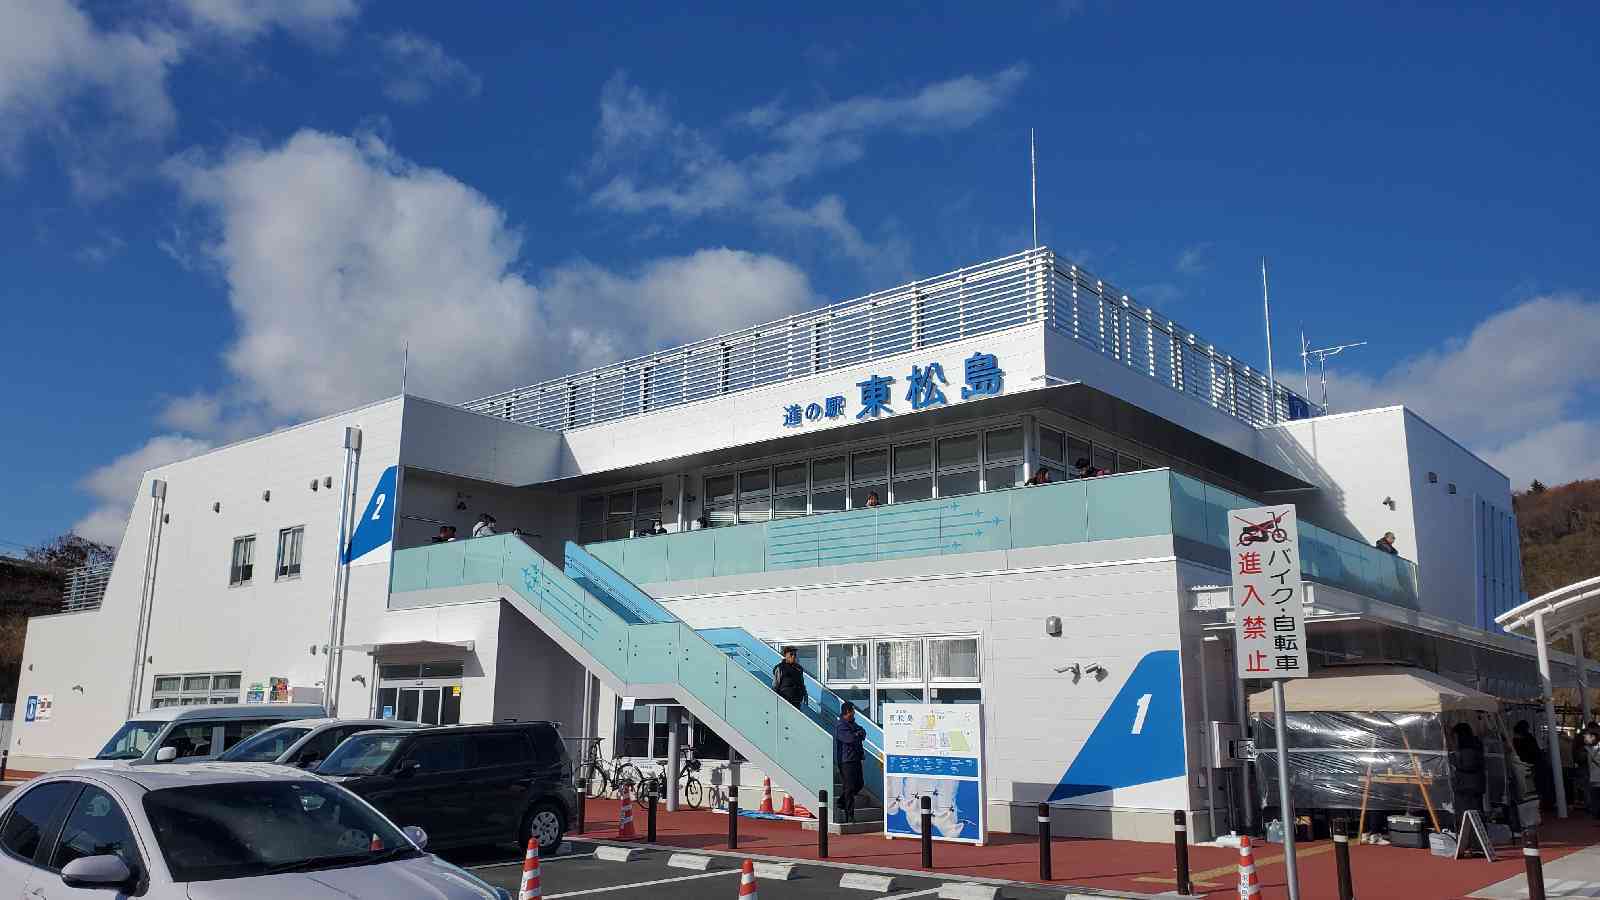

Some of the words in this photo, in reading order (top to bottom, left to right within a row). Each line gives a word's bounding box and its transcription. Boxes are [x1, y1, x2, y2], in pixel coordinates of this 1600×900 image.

[783, 395, 847, 428] 道の駅
[856, 351, 1005, 419] 東松島
[371, 493, 386, 520] 2
[1238, 551, 1270, 672] 進入禁止
[1268, 548, 1299, 671] バイク・自転車
[1131, 693, 1153, 735] 1
